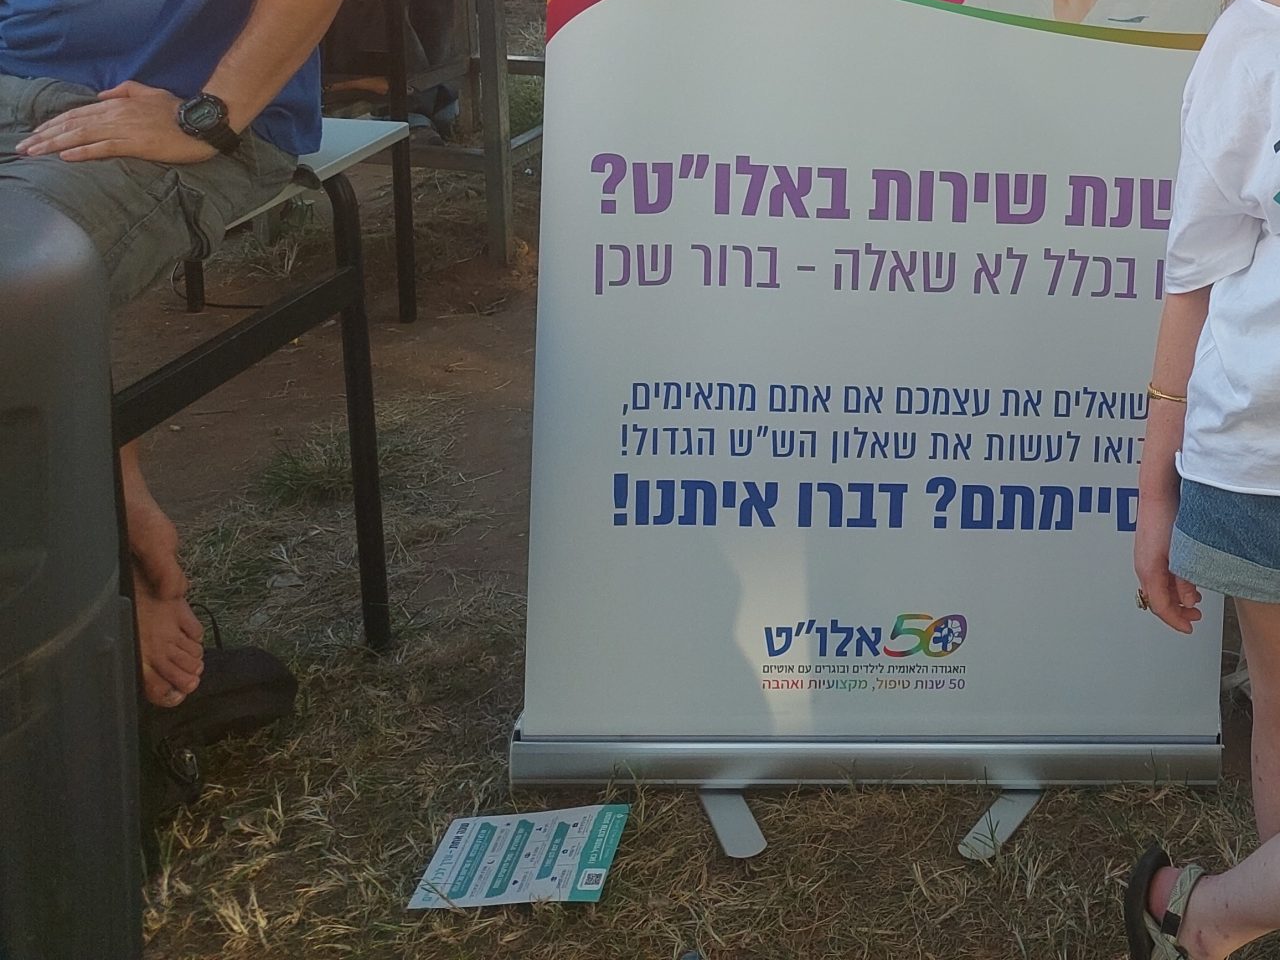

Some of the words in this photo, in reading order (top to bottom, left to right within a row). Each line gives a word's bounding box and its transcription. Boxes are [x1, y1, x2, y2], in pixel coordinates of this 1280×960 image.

[868, 168, 1048, 225] שירות
[1064, 175, 1173, 231] שנת
[594, 243, 673, 296] שכן
[690, 244, 781, 289] ברור
[833, 242, 957, 293] שאלה
[973, 246, 1029, 295] לא
[1043, 247, 1138, 299] בכלל
[622, 381, 756, 416] מתאימים,
[769, 384, 832, 413] אתם
[843, 385, 884, 414] אם
[895, 386, 990, 418] עצמכם
[999, 389, 1042, 417] את
[1053, 386, 1149, 421] שואלים
[621, 423, 715, 457] הגדול!
[831, 426, 917, 464] שאלון
[928, 432, 972, 461] את
[983, 430, 1081, 463] לעשות
[613, 472, 779, 528] איתנו!
[797, 482, 909, 529] דברו
[925, 476, 1140, 532] סיימתם?
[762, 664, 795, 675] אוטיזם
[762, 679, 804, 691] ואהבה
[797, 664, 812, 675] עם
[814, 664, 850, 675] ובוגרים
[852, 663, 885, 675] לילדים
[871, 677, 911, 693] טיפול,
[886, 663, 929, 675] הלאומית
[913, 679, 946, 690] שנות
[931, 664, 966, 675] האגודה
[948, 678, 966, 690] 50
[807, 679, 868, 693] מקצועיות
